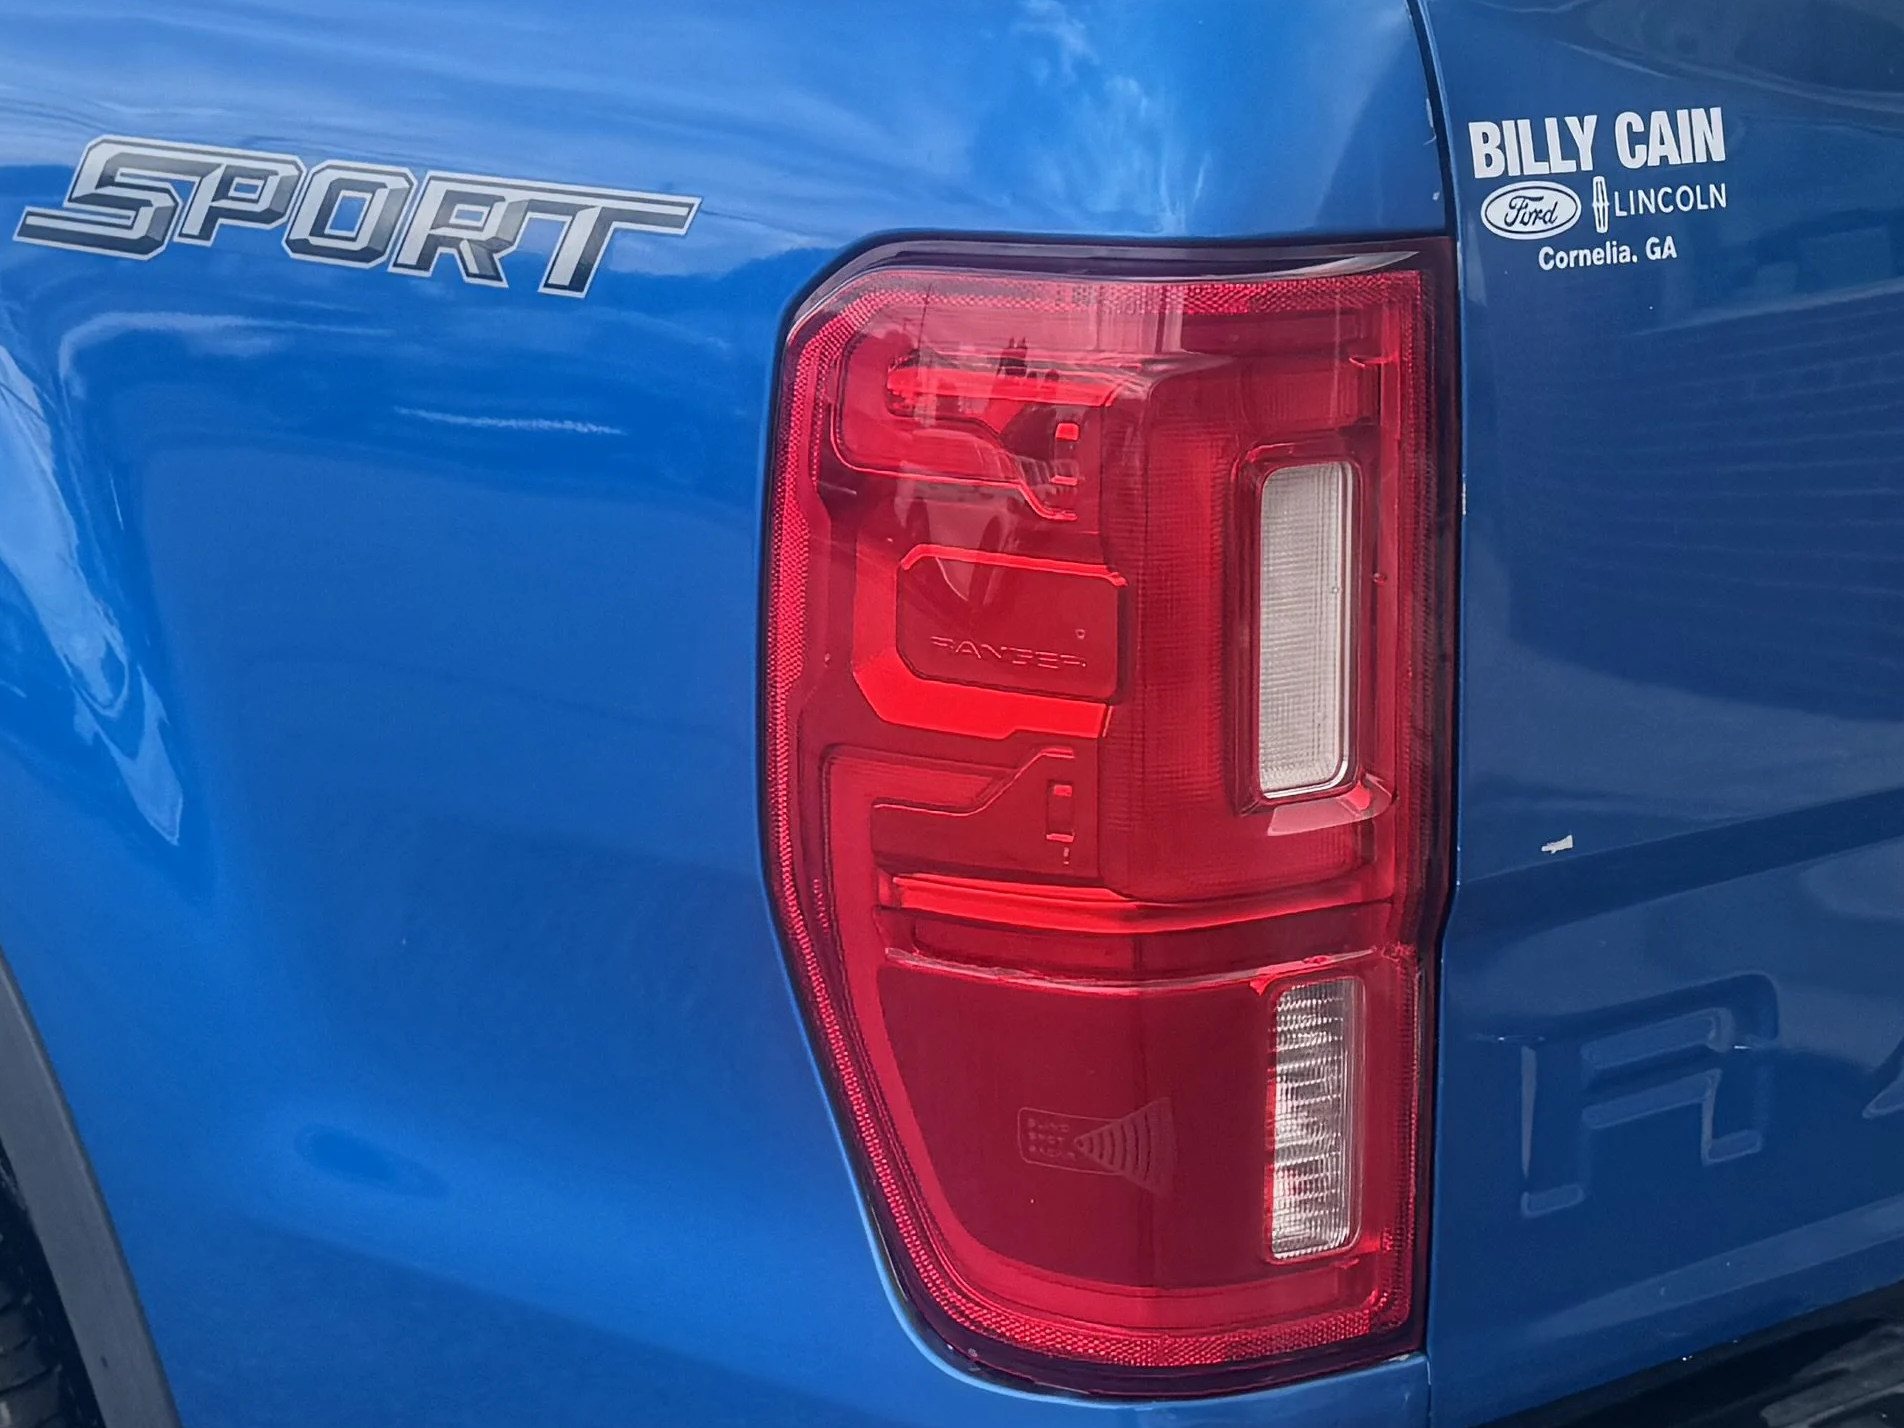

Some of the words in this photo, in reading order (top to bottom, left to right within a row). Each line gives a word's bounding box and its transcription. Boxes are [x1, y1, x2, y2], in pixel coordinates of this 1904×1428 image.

[1468, 114, 1597, 178] BILLY
[1615, 107, 1726, 169] CAIN
[12, 134, 703, 298] SPORT
[1503, 195, 1559, 228] Ford
[1614, 183, 1727, 217] LINCOLN
[1646, 235, 1677, 261] GA
